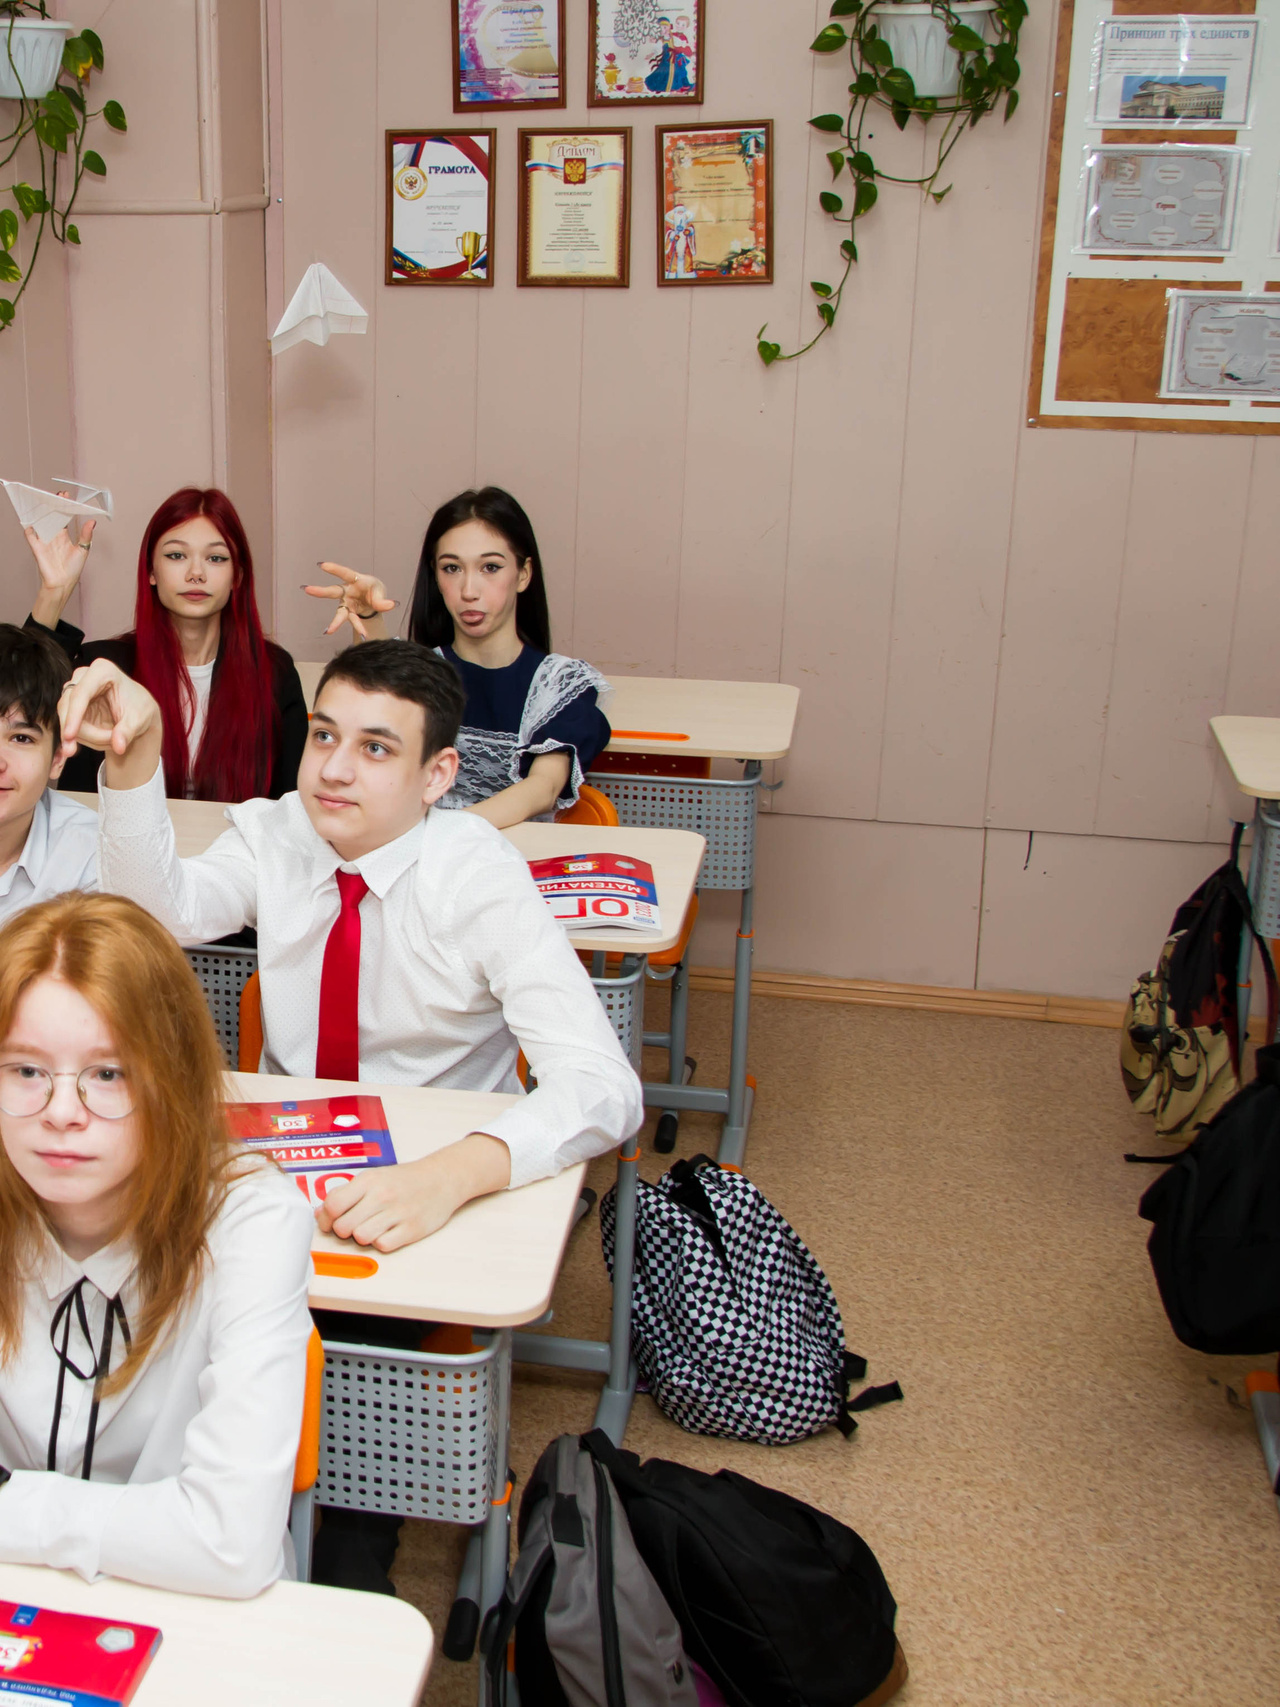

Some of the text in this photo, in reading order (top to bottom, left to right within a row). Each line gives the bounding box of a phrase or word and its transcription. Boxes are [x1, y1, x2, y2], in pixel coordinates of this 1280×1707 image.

[1109, 26, 1166, 42] Принцип
[1200, 28, 1250, 40] единств
[428, 165, 476, 174] ГРАМОТА
[536, 882, 641, 893] МАТЕМАТИК
[545, 898, 629, 919] ОГ
[282, 1120, 302, 1128] 30
[272, 1146, 342, 1160] ХИМИ
